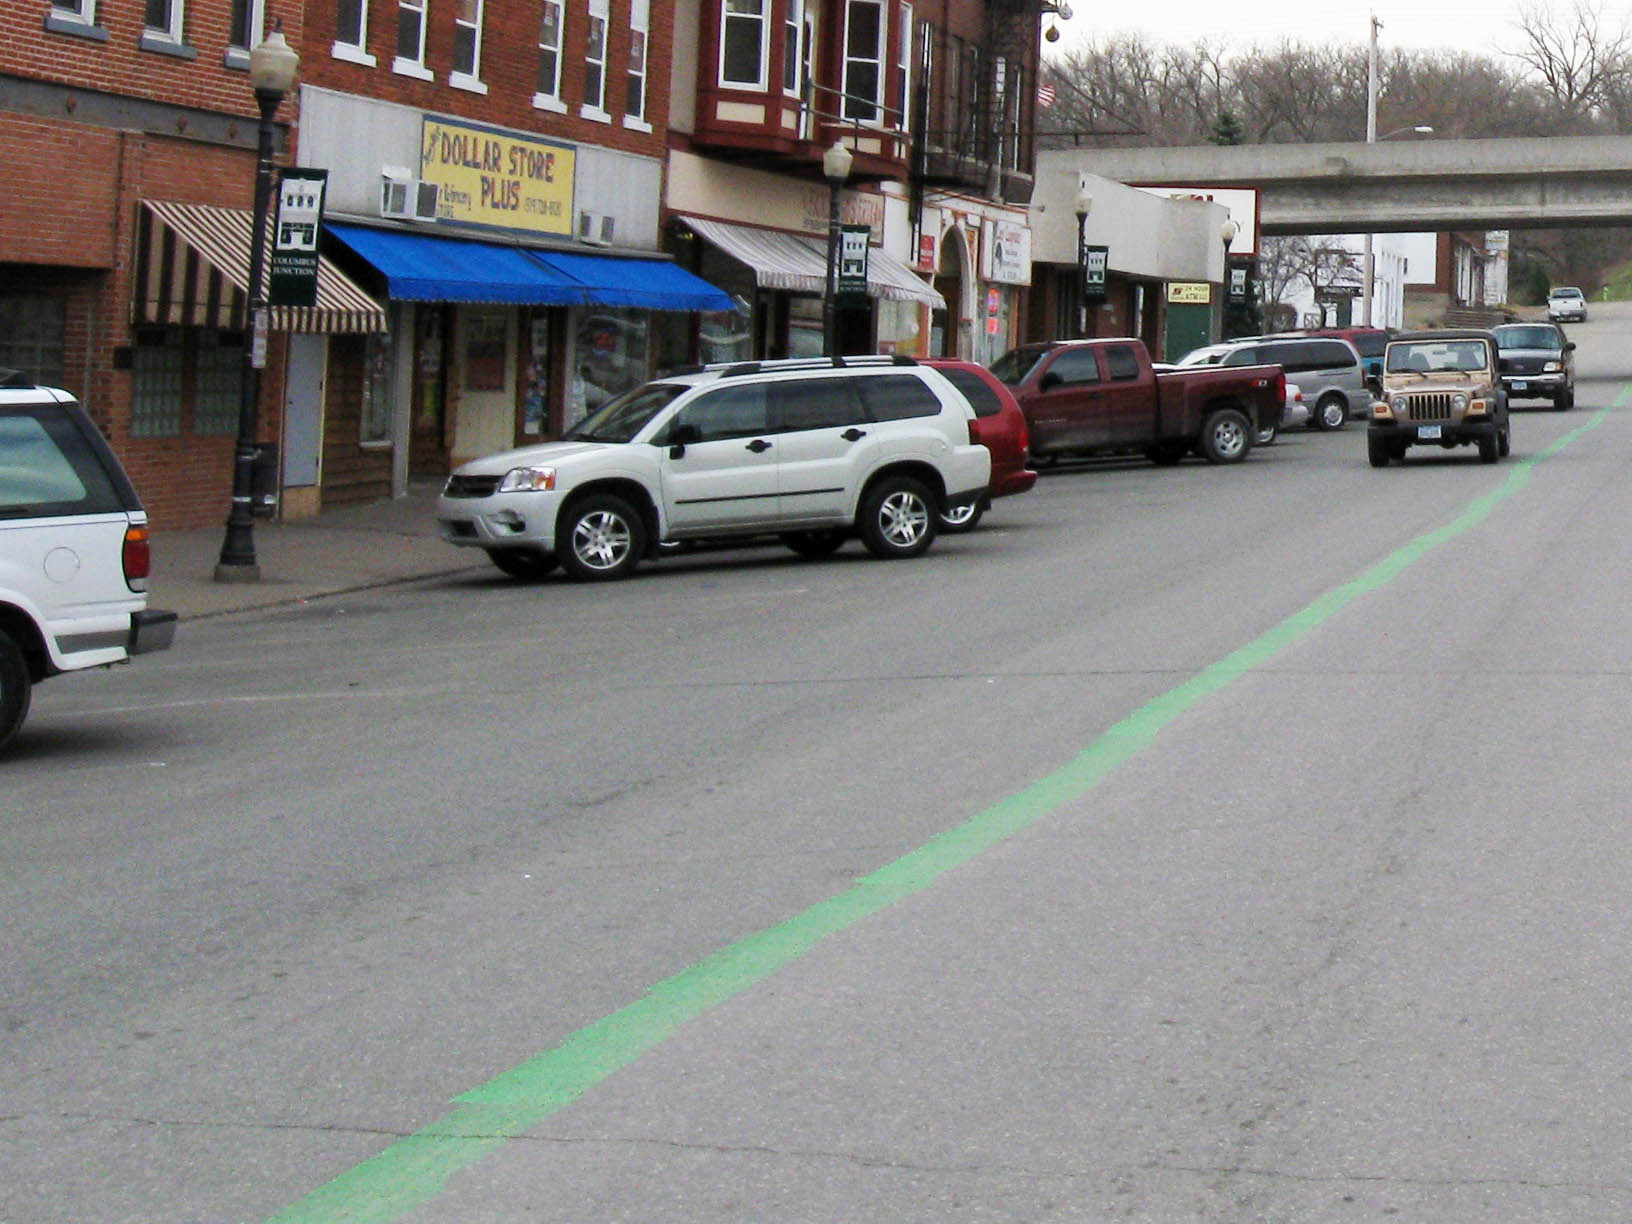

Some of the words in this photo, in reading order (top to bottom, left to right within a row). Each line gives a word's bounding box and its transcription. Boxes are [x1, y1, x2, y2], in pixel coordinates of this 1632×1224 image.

[441, 130, 502, 173] DOLLAR
[508, 144, 555, 183] STORE
[480, 175, 520, 211] PLUS
